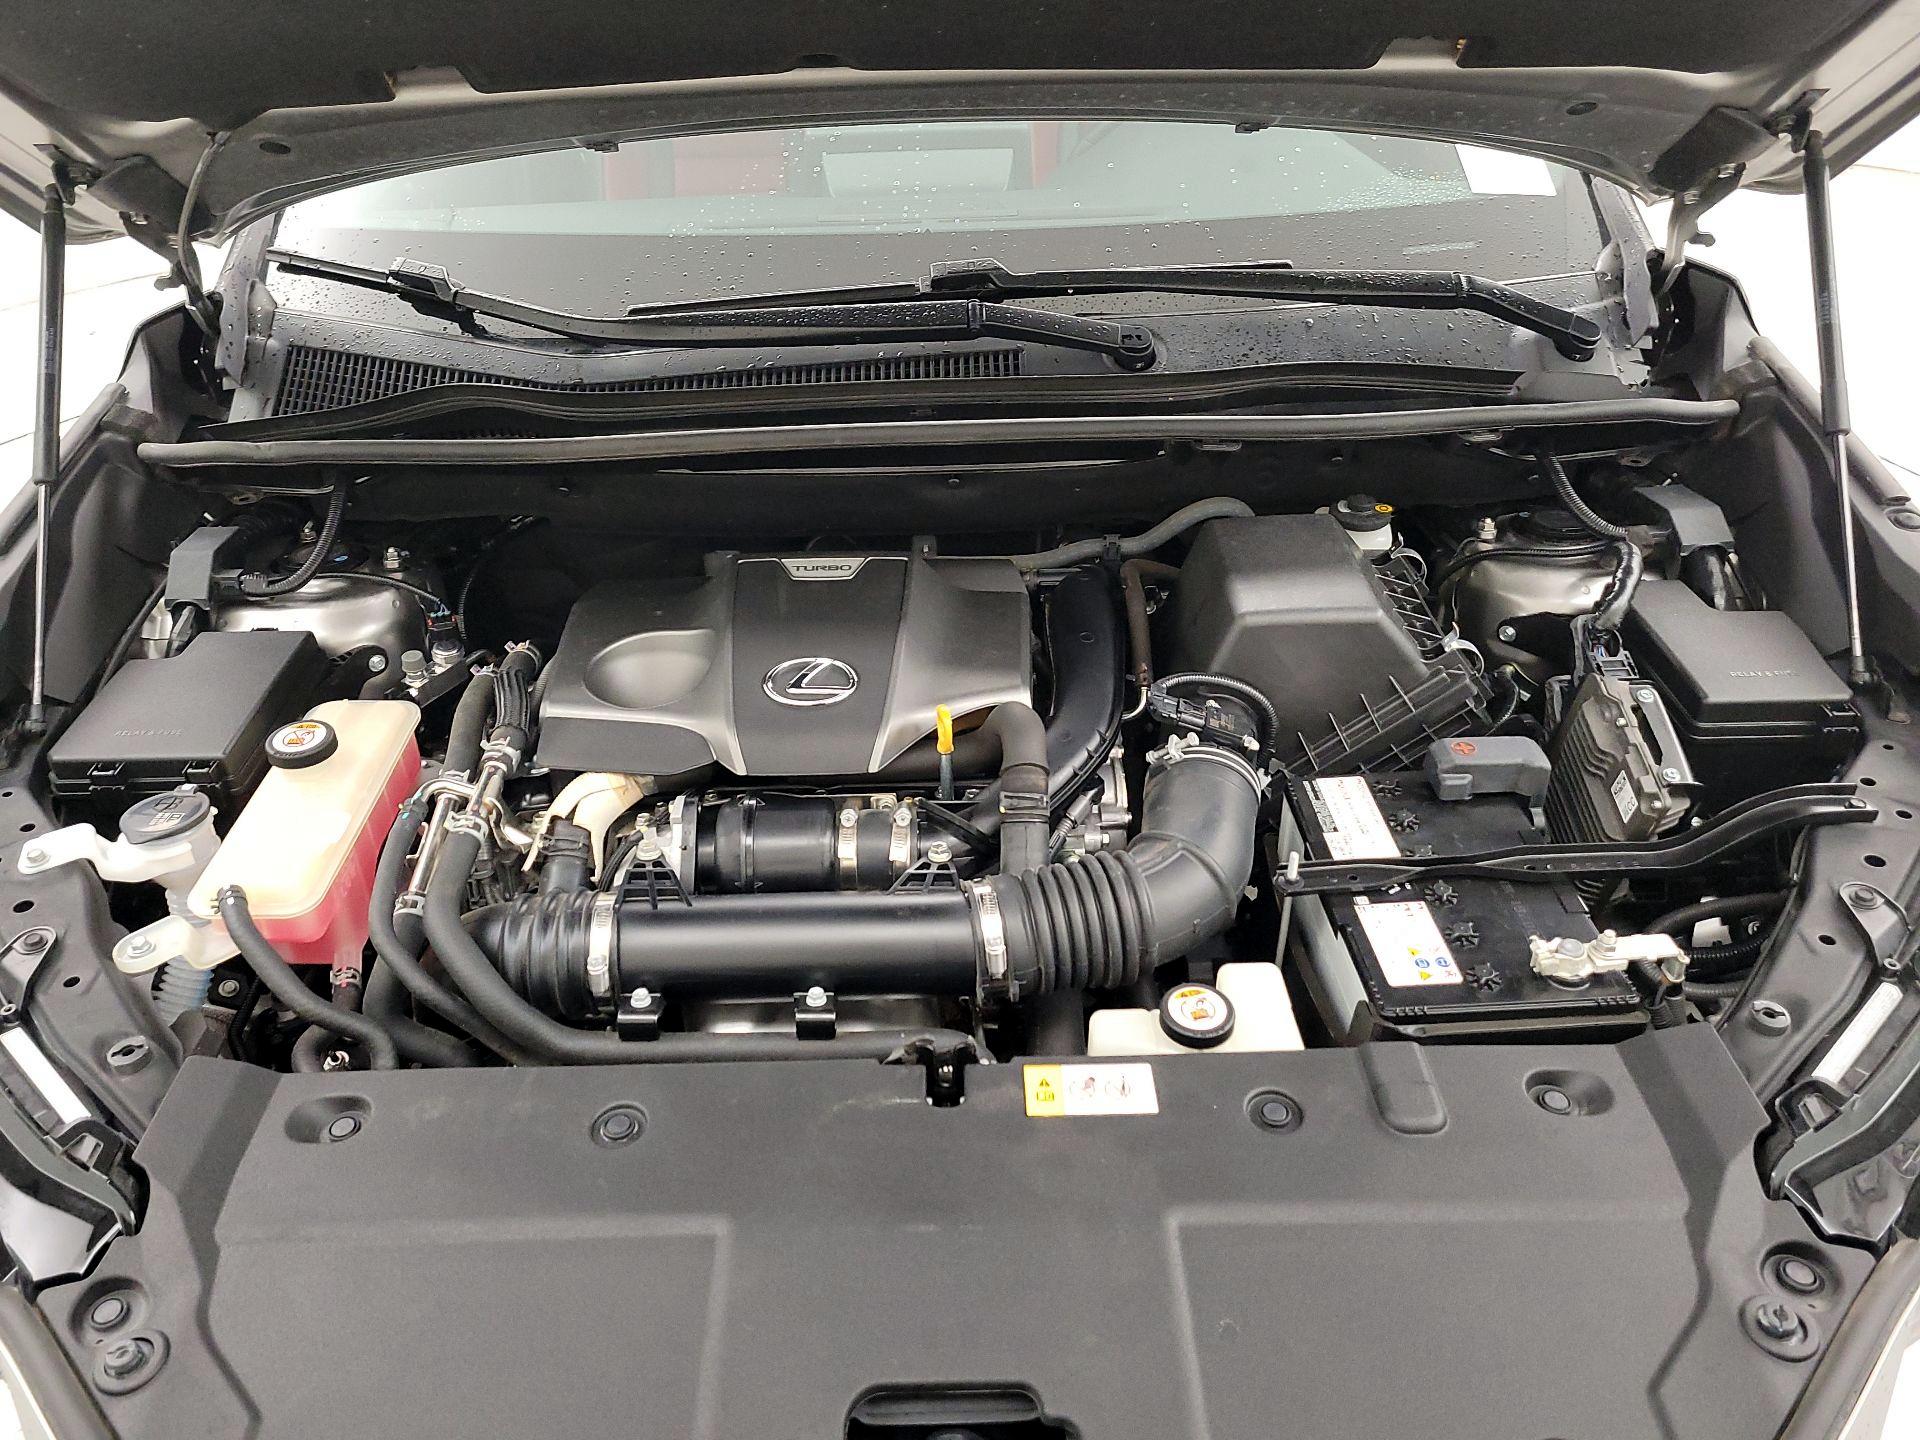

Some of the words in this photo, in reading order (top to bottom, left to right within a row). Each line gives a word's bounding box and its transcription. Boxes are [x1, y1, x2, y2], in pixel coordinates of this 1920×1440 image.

[791, 564, 852, 572] TURBO
[1730, 670, 1762, 678] RELAY
[1774, 670, 1800, 678] FU
[114, 729, 147, 737] RELAY
